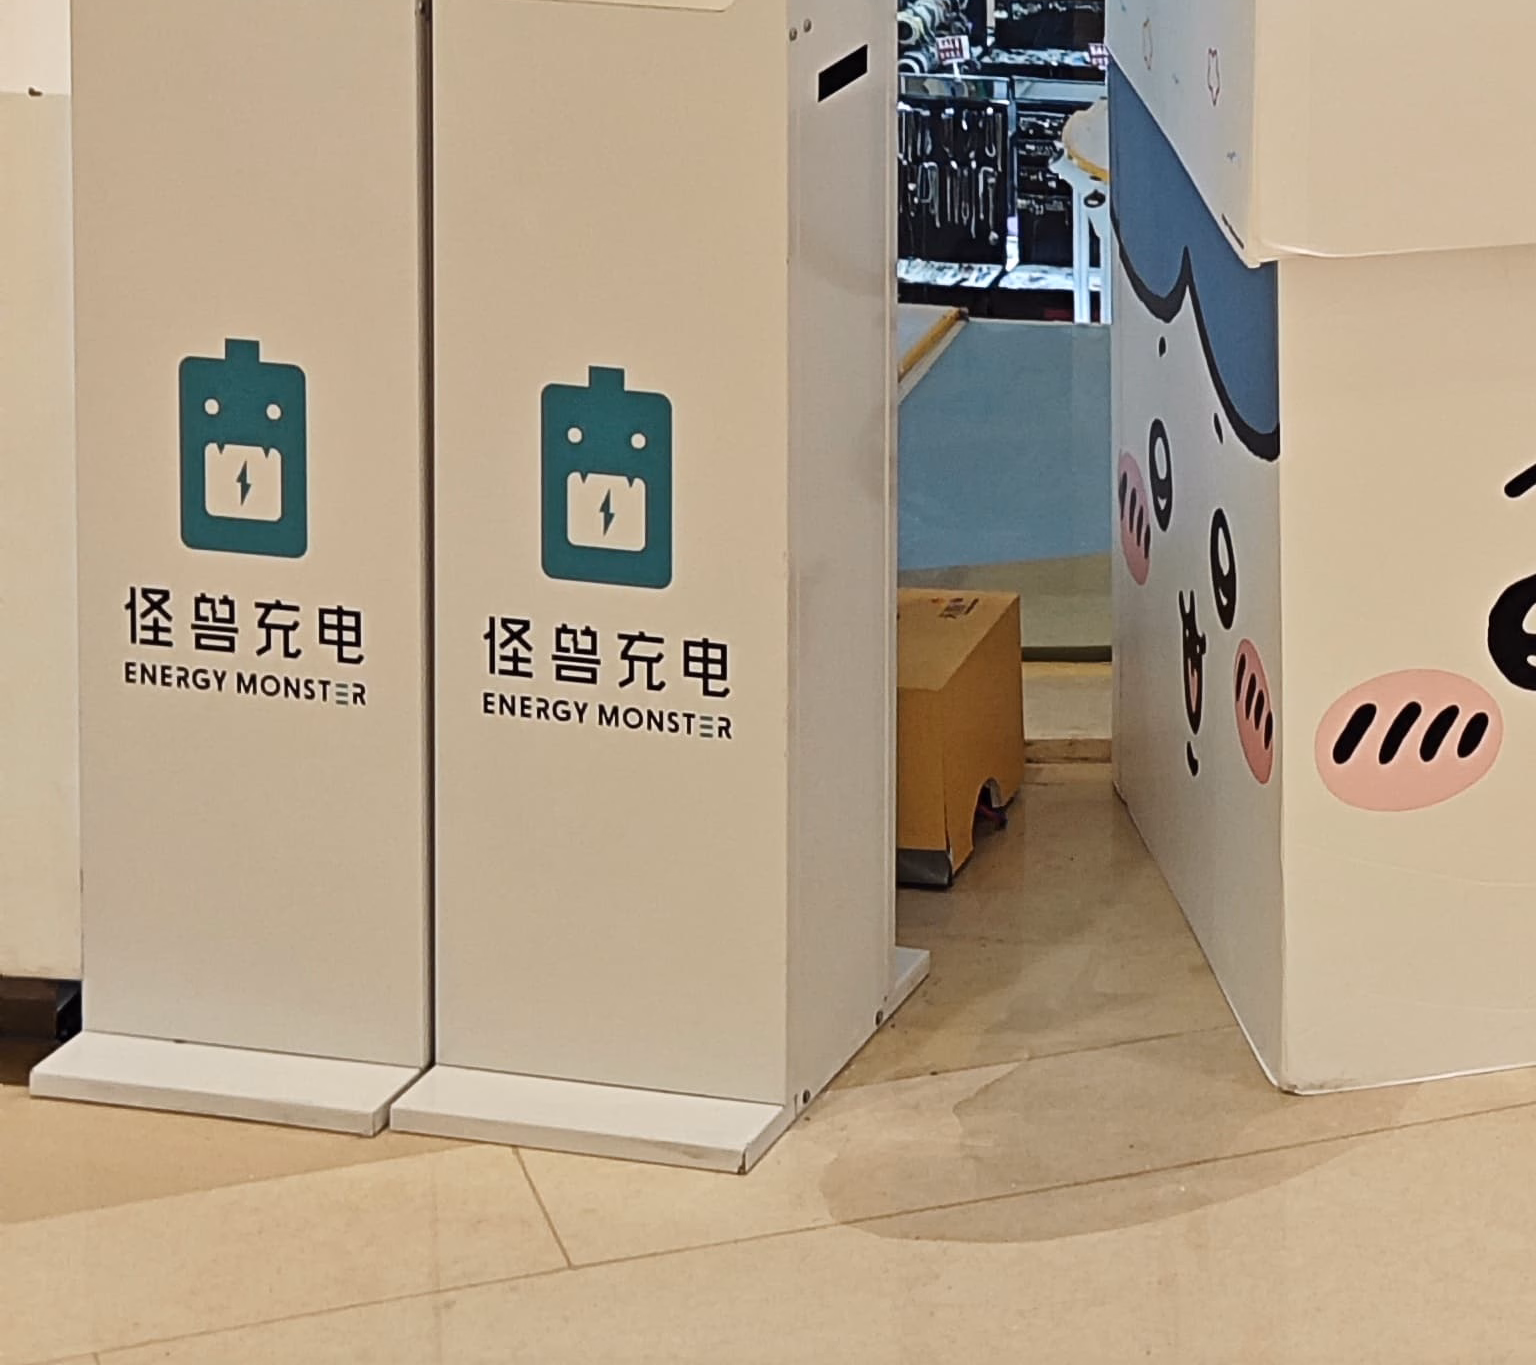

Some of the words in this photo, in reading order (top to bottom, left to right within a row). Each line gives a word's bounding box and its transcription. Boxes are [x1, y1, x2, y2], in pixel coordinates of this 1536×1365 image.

[124, 585, 364, 665] 怪兽充电
[483, 616, 730, 698] 怪兽充电
[124, 661, 227, 692] ENERGY
[235, 672, 366, 706] MONSTER
[482, 691, 588, 724] ENERGY
[598, 703, 732, 740] MONSTER
